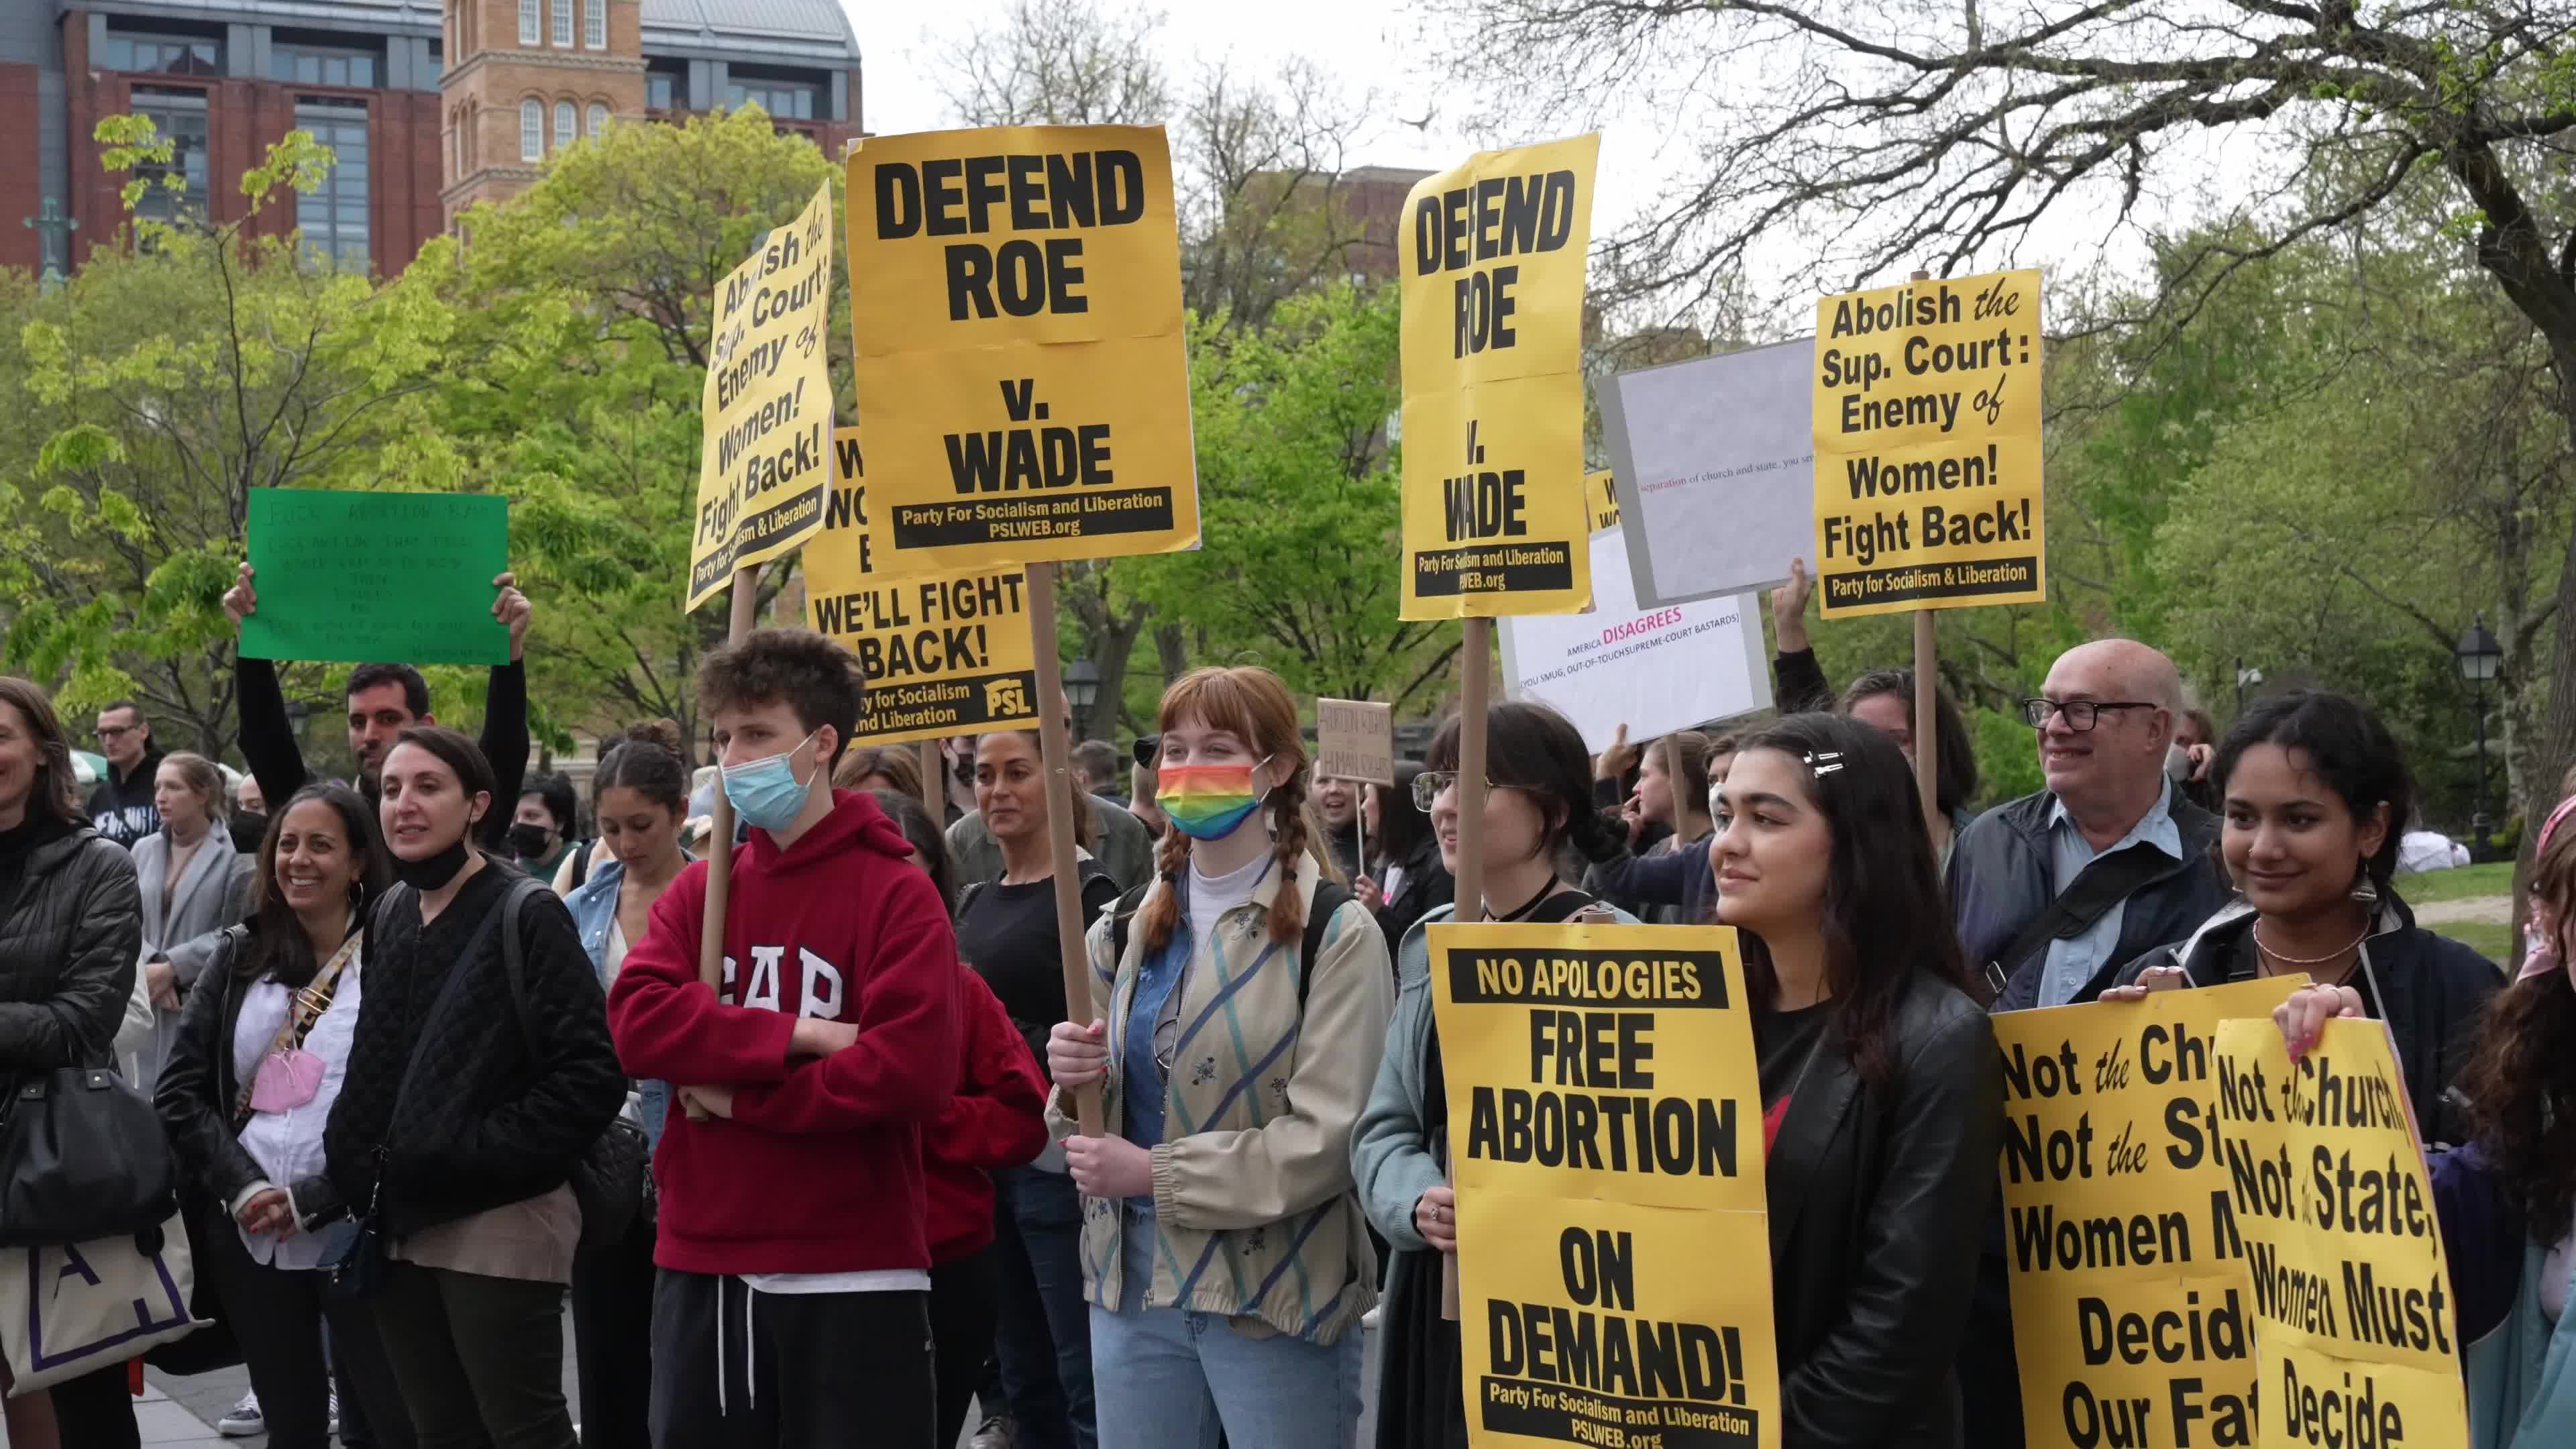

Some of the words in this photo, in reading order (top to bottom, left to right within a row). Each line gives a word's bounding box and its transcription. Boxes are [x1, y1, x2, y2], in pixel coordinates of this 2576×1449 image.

[875, 150, 1144, 239] DEFEND
[806, 201, 823, 258] the
[753, 255, 826, 327] Court:
[945, 238, 1087, 321] ROE
[1454, 266, 1518, 359] ROE
[1831, 285, 1960, 338] Abolish
[1974, 277, 2019, 320] the
[718, 334, 788, 413] Enemy
[796, 305, 816, 360] of
[1823, 350, 1890, 392] Sup.
[1904, 328, 2028, 375] Court:
[719, 376, 805, 477] Women!
[1842, 392, 1961, 433] Enemy
[1974, 373, 2006, 425] of
[745, 423, 818, 501] Back!
[944, 424, 1113, 494] WADE
[1689, 472, 1699, 484] of
[1702, 468, 1734, 482] church
[1735, 464, 1754, 476] and
[1846, 444, 1996, 499] Women!
[902, 509, 943, 526] Party
[947, 507, 971, 521] For
[976, 502, 1049, 519] Socialism
[1053, 498, 1079, 514] and
[1084, 494, 1162, 512] Liberation
[990, 519, 1081, 539] PSLWEB.org
[1444, 470, 1527, 542] WADE
[1825, 511, 1910, 566] Fight
[1923, 498, 2030, 547] Back!
[696, 561, 716, 585] Party
[716, 551, 728, 570] for
[758, 518, 767, 536] &
[769, 497, 816, 533] Liberation
[1417, 555, 1440, 576] Party
[1440, 554, 1455, 572] For
[1482, 551, 1504, 568] and
[1507, 547, 1564, 566] Liberation
[815, 588, 910, 635] WE'LL
[920, 574, 1023, 623] FIGHT
[1833, 579, 1863, 598] Party
[1866, 575, 1883, 592] for
[1886, 569, 1940, 590] Socialism
[1945, 570, 1954, 585] &
[1958, 564, 2027, 584] Liberation
[858, 625, 988, 680] BACK!
[1540, 668, 1566, 683] SMUG,
[1695, 612, 1739, 634] BASTARDS)
[1567, 639, 1601, 657] AMERICA
[1603, 607, 1682, 645] DISAGREES
[875, 691, 895, 708] for
[898, 684, 969, 705] Socialism
[983, 679, 1030, 716] PSL
[882, 707, 957, 729] Liberation
[1477, 959, 1523, 995] NO
[1532, 959, 1701, 999] APOLOGIES
[1530, 1009, 1654, 1089] FREE
[2002, 1040, 2081, 1102] Not
[2096, 1038, 2129, 1093] the
[2218, 1055, 2275, 1122] Not
[1468, 1087, 1737, 1177] ABORTION
[2010, 1112, 2092, 1184] Not
[2108, 1121, 2147, 1175] the
[2225, 1138, 2295, 1221] Not
[2313, 1144, 2438, 1258] State,
[1560, 1227, 1634, 1311] ON
[2011, 1204, 2190, 1273] Women
[2078, 1289, 2255, 1365] Decid
[2245, 1241, 2337, 1338] Women
[2342, 1261, 2450, 1354] Must
[1487, 1298, 1746, 1405] DEMAND!
[1490, 1383, 1529, 1409] Party
[1533, 1388, 1556, 1409] For
[1559, 1391, 1622, 1422] Socialism
[1626, 1407, 1659, 1425] and
[1664, 1407, 1749, 1436] Liberation
[1572, 1418, 1664, 1448] PSLWEB.org
[2063, 1381, 2150, 1448] Our
[2284, 1358, 2403, 1448] Decide
